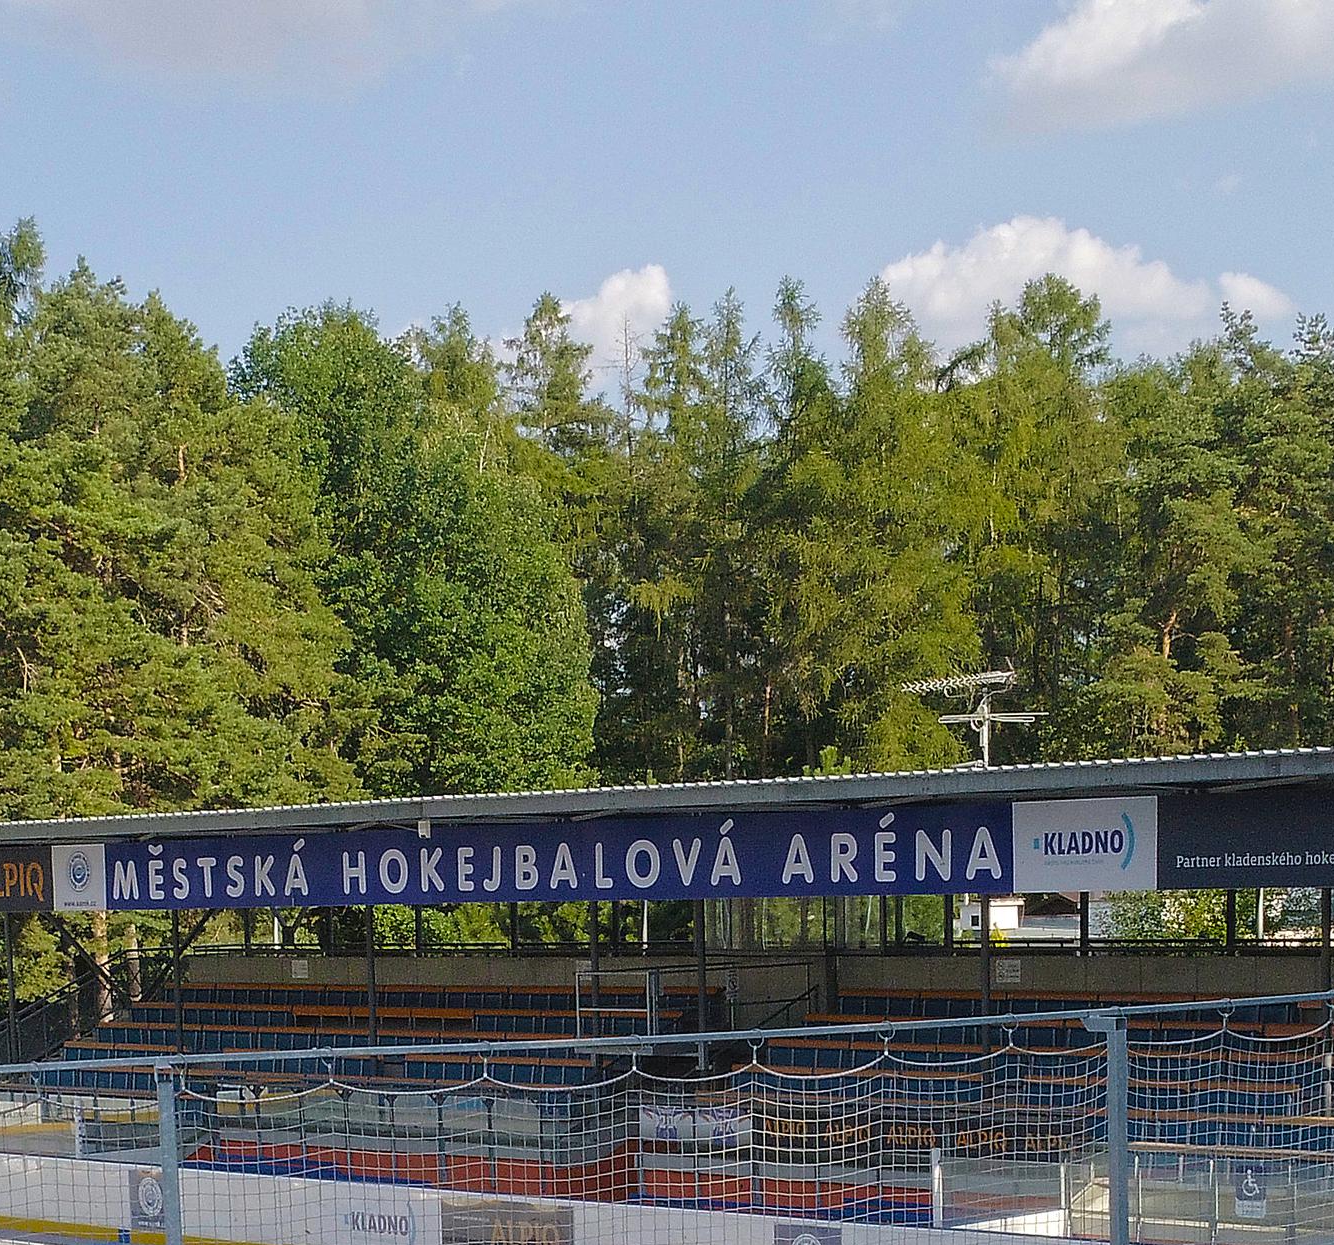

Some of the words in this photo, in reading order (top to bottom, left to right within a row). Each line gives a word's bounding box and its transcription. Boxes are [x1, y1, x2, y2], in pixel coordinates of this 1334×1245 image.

[1043, 829, 1124, 856] KLADNO
[113, 838, 308, 900] MĚSTSKÁ
[343, 818, 741, 896] HOKEJBALOVÁ
[782, 812, 1003, 884] ARÉNA
[1176, 855, 1221, 869] Partner
[1224, 852, 1302, 867] kladenského
[351, 1211, 409, 1237] KLADNO
